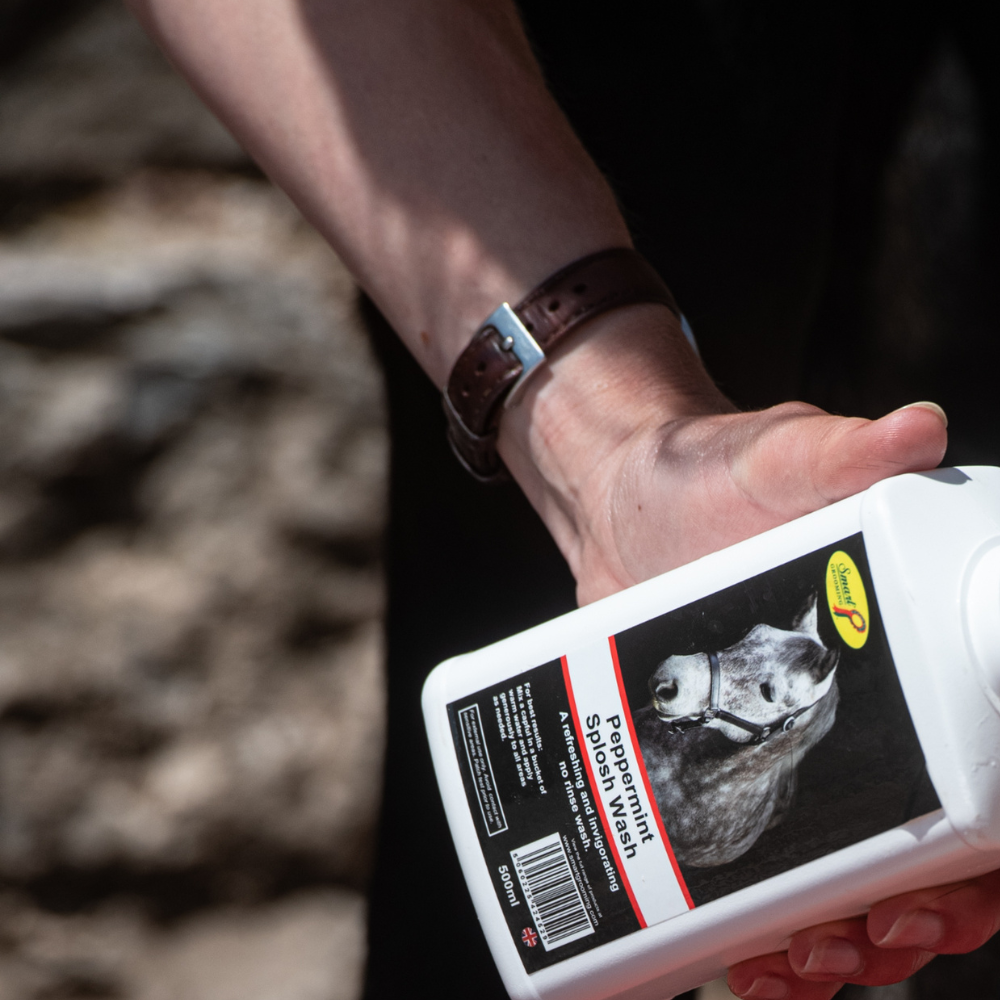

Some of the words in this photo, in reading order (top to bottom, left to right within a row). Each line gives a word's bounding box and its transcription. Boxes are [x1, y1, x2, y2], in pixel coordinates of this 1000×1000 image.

[492, 695, 499, 707] as
[523, 682, 531, 697] For
[495, 707, 507, 741] needed.
[499, 692, 515, 739] generously
[526, 698, 536, 718] best
[559, 711, 569, 722] A
[508, 688, 517, 713] warm
[513, 713, 523, 737] water
[518, 739, 528, 756] and
[523, 757, 533, 780] apply
[510, 740, 517, 750] to
[531, 719, 543, 751] results:
[513, 751, 521, 762] all
[520, 710, 532, 737] capful
[527, 737, 533, 747] in
[531, 754, 544, 784] bucket
[539, 785, 547, 794] of
[562, 723, 585, 789] refreshing
[516, 763, 526, 787] areas
[585, 713, 616, 792] Splosh
[609, 794, 637, 859] Wash
[606, 714, 655, 844] Peppermint
[558, 761, 569, 778] no
[564, 780, 579, 812] rinse
[574, 814, 591, 852] wash.
[580, 791, 595, 815] and
[588, 816, 619, 892] invigorating
[498, 865, 520, 907] 500ml
